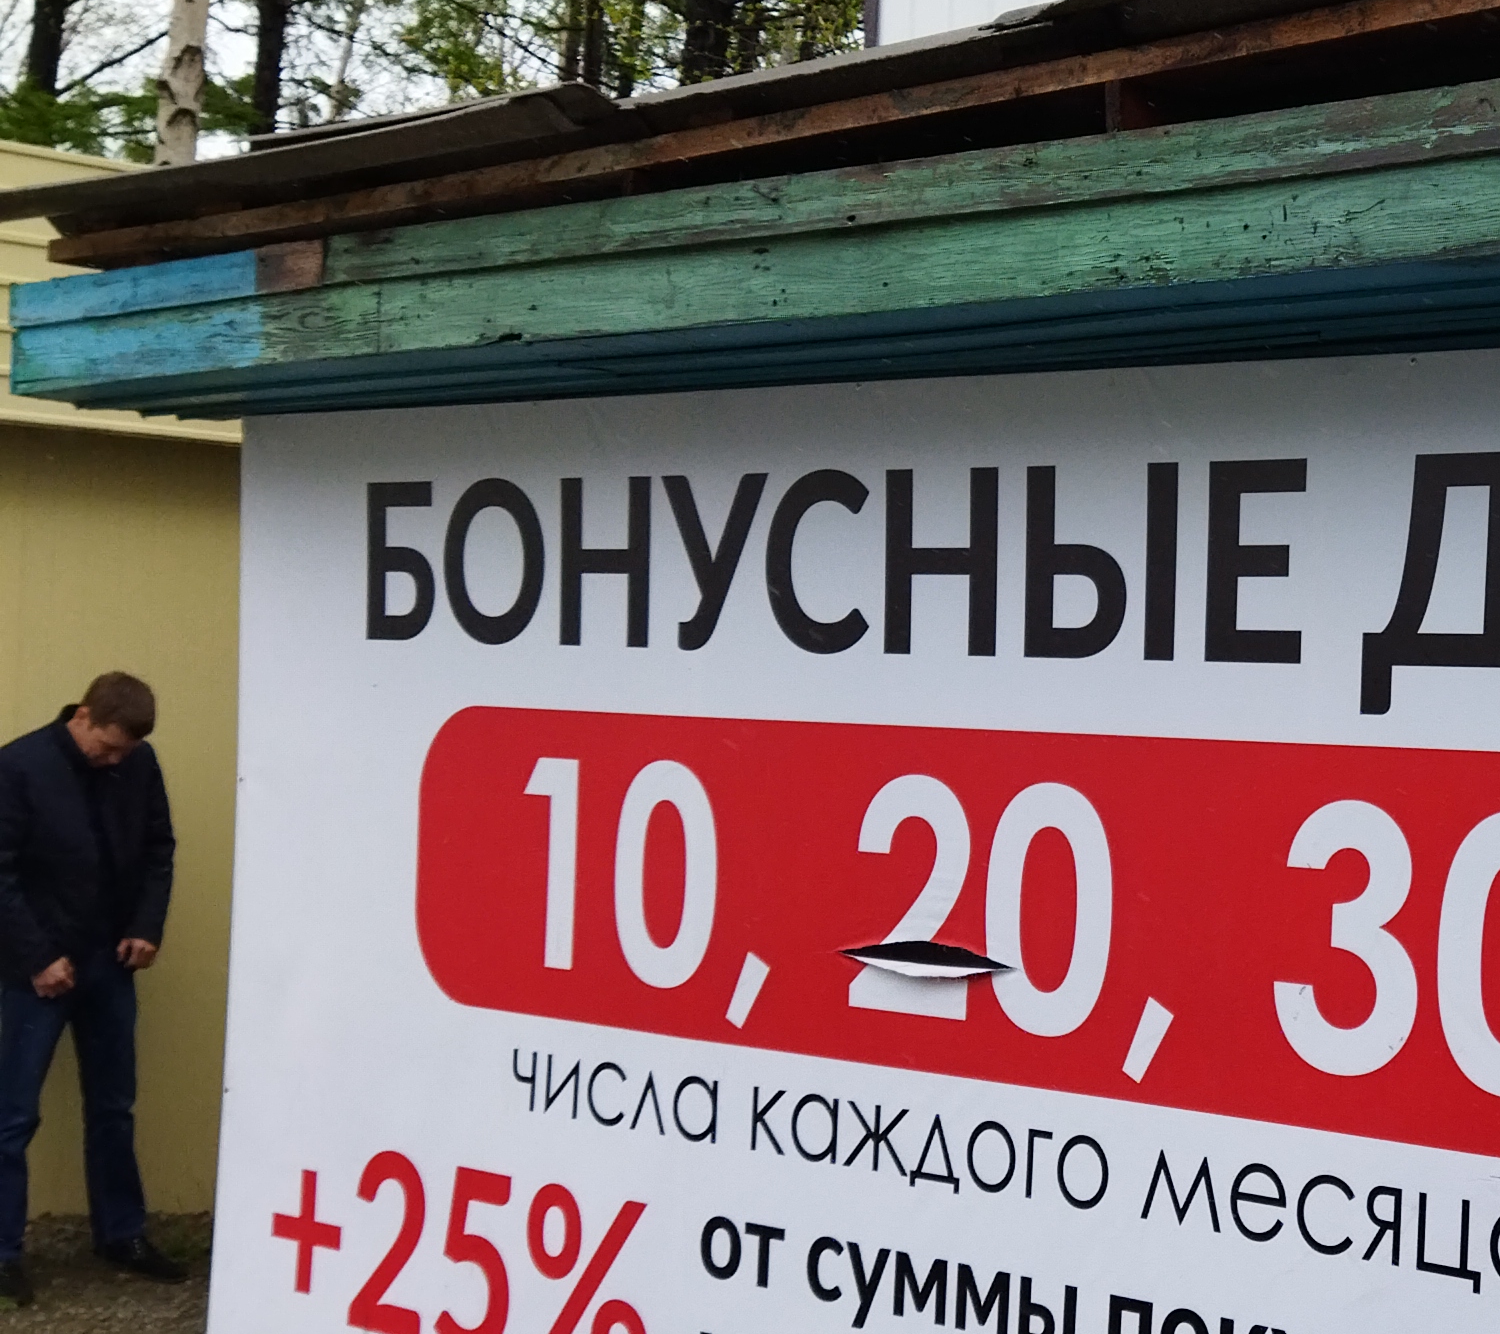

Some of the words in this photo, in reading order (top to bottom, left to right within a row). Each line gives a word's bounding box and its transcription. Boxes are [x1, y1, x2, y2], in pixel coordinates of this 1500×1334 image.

[366, 458, 1309, 664] БОНУСНЫЕ
[522, 755, 773, 1030] 10,
[844, 772, 1175, 1082] 20,
[509, 1046, 719, 1146] числа
[748, 1082, 1110, 1212] каждого
[699, 1215, 786, 1289] от
